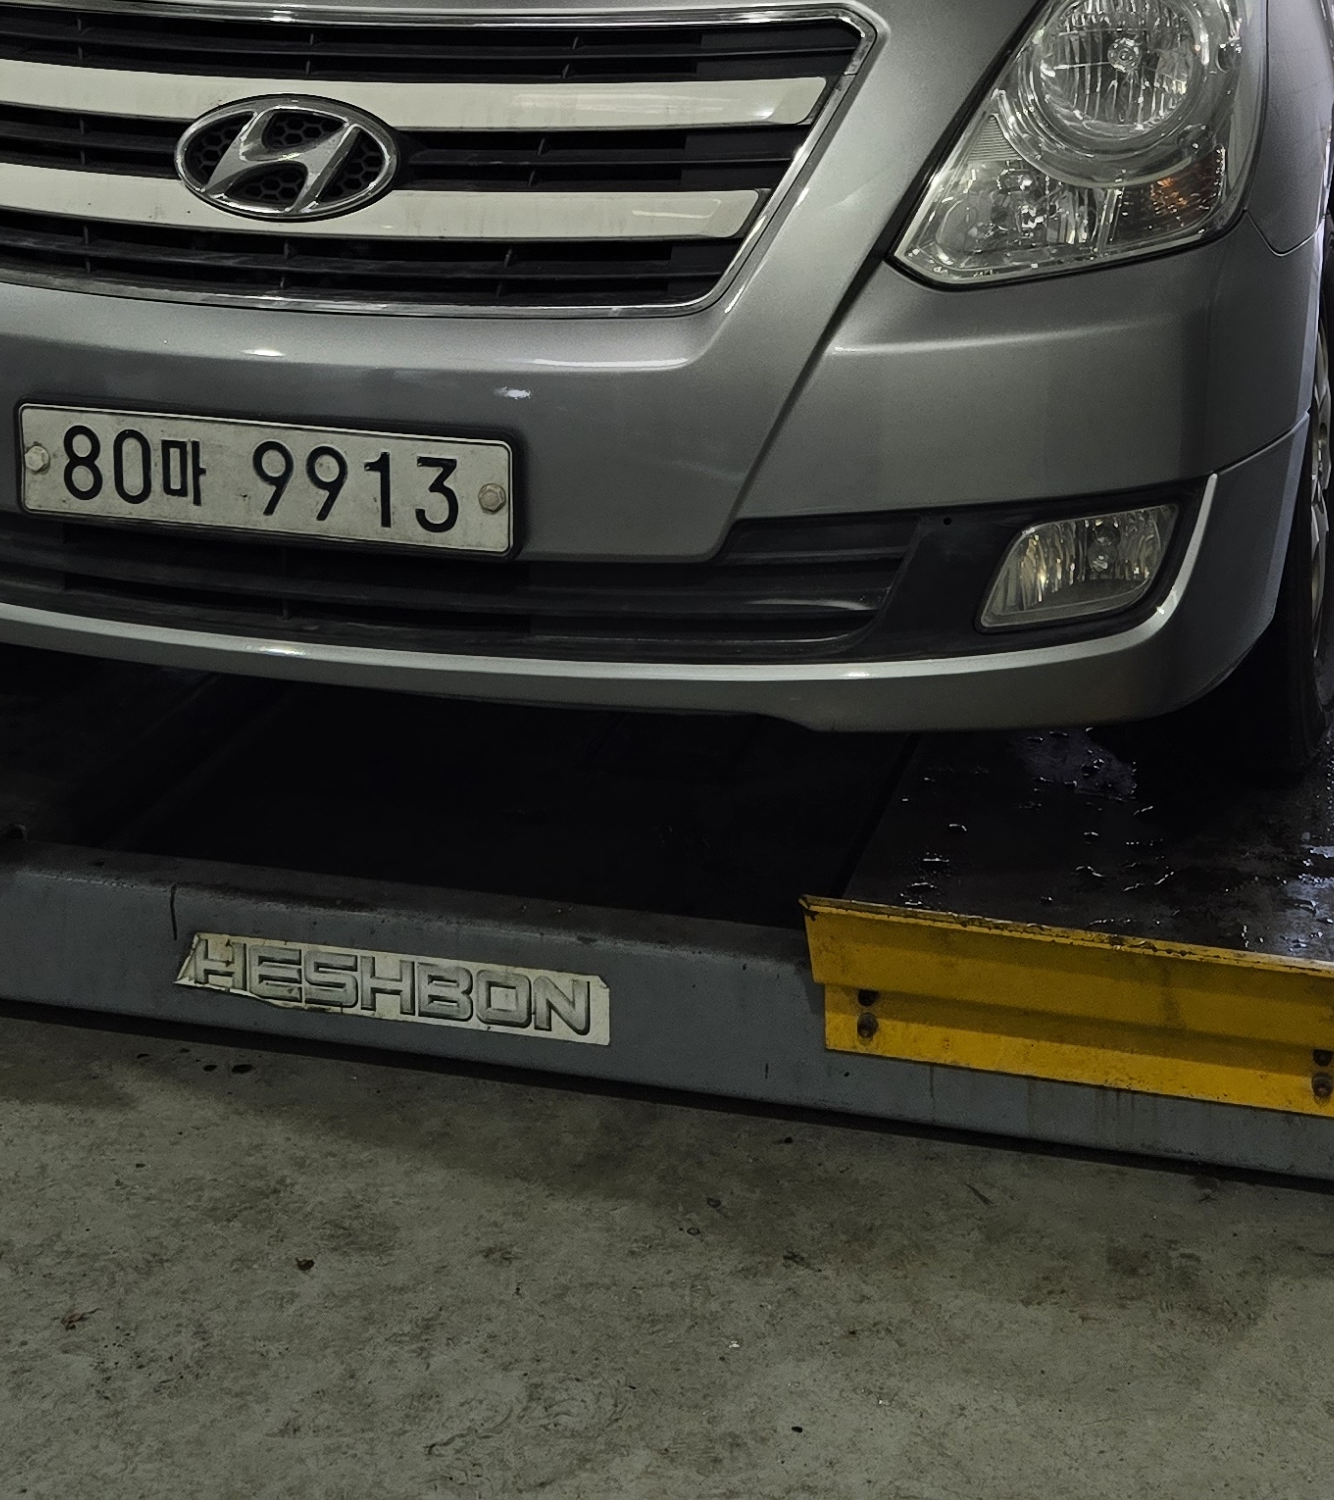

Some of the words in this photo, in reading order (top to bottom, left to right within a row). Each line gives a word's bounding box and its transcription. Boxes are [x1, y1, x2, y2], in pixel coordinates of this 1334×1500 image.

[62, 424, 207, 507] 80마
[252, 439, 460, 533] 9913
[194, 937, 591, 1036] HESHBON
